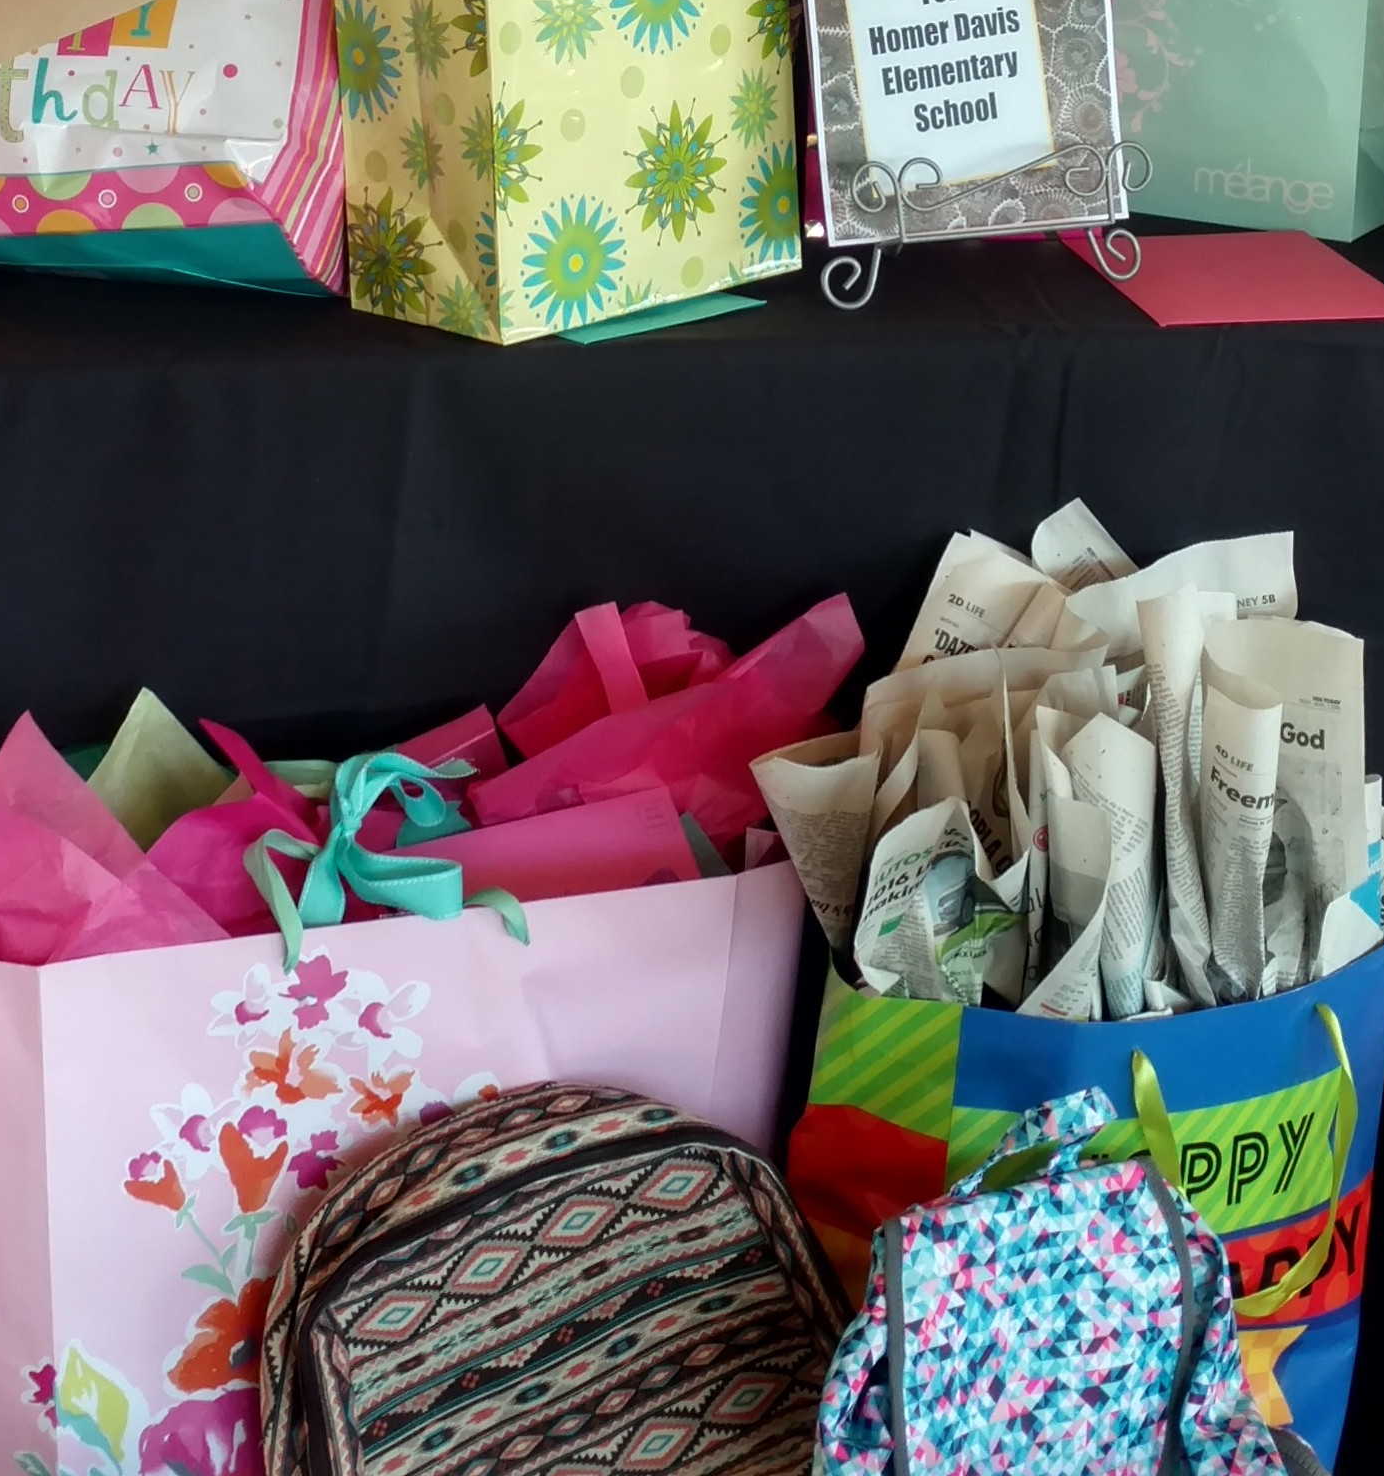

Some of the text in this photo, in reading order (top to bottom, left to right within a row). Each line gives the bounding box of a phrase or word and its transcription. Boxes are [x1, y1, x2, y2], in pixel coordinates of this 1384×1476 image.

[868, 8, 1021, 56] Homer Davis
[881, 50, 1018, 97] Elementary
[913, 92, 999, 134] School
[964, 601, 987, 619] LIFE
[1279, 721, 1325, 751] God
[1230, 756, 1255, 772] LIFE
